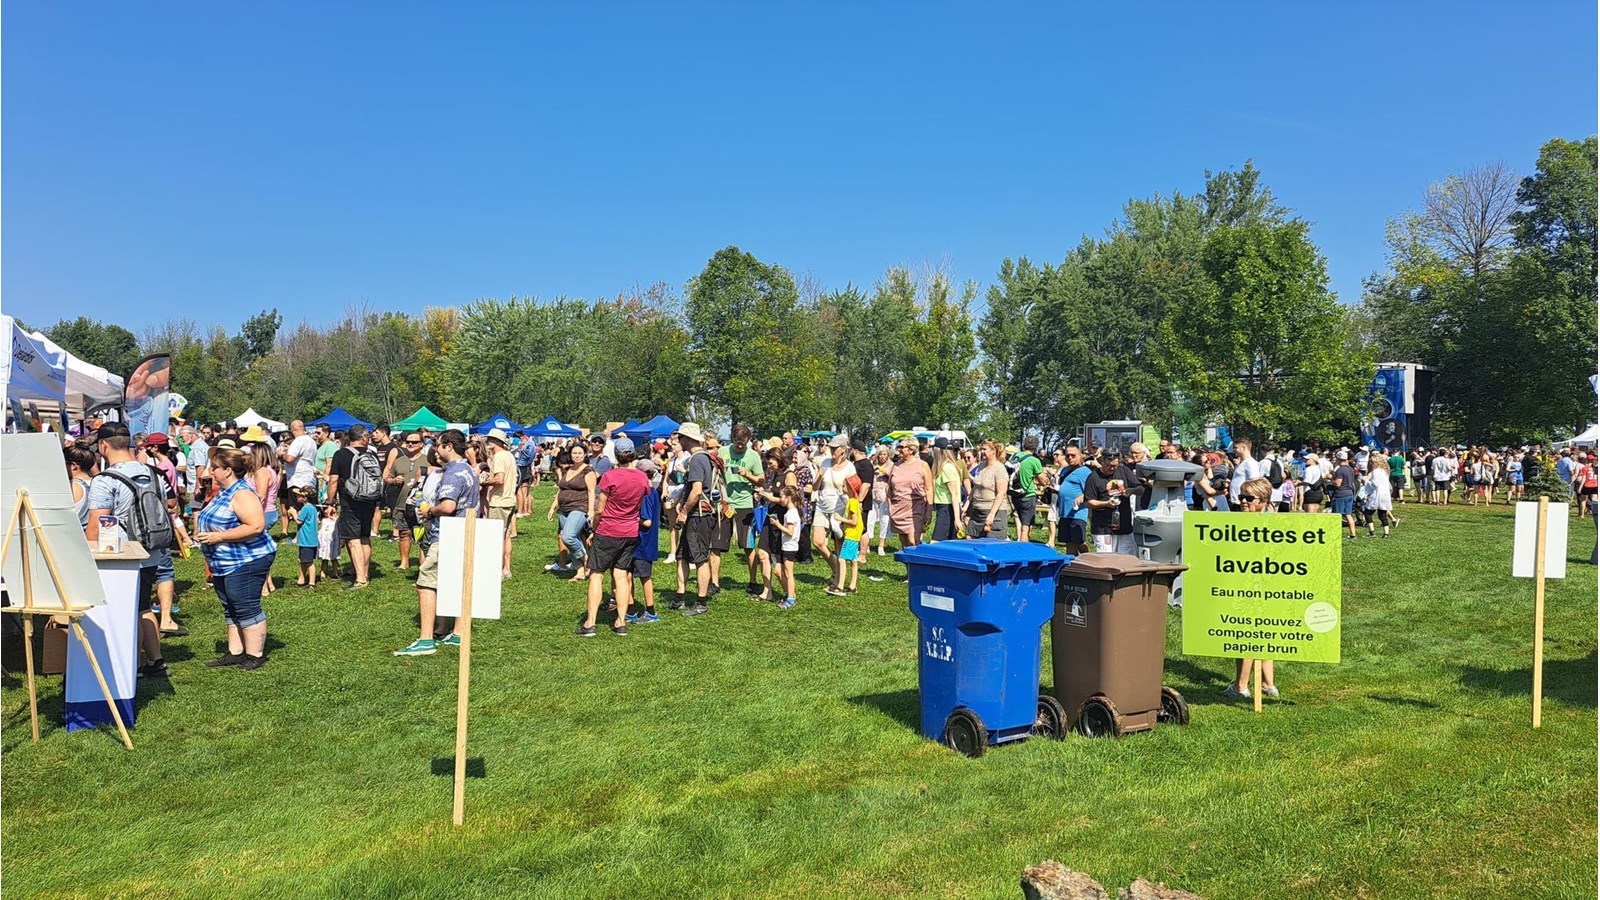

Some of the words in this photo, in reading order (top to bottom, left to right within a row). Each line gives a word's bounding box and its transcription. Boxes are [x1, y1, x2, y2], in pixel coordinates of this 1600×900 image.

[1194, 524, 1297, 544] Toilettes
[1302, 528, 1326, 544] et
[1215, 555, 1308, 576] lavabos
[1211, 587, 1234, 597] Eau
[1237, 589, 1262, 598] non
[1264, 589, 1314, 601] potable
[1220, 614, 1252, 625] Vous
[1254, 617, 1302, 627] pouvez
[1207, 628, 1277, 640] composter
[1280, 632, 1314, 641] votre
[1223, 642, 1265, 653] papier
[1267, 643, 1298, 654] brun
